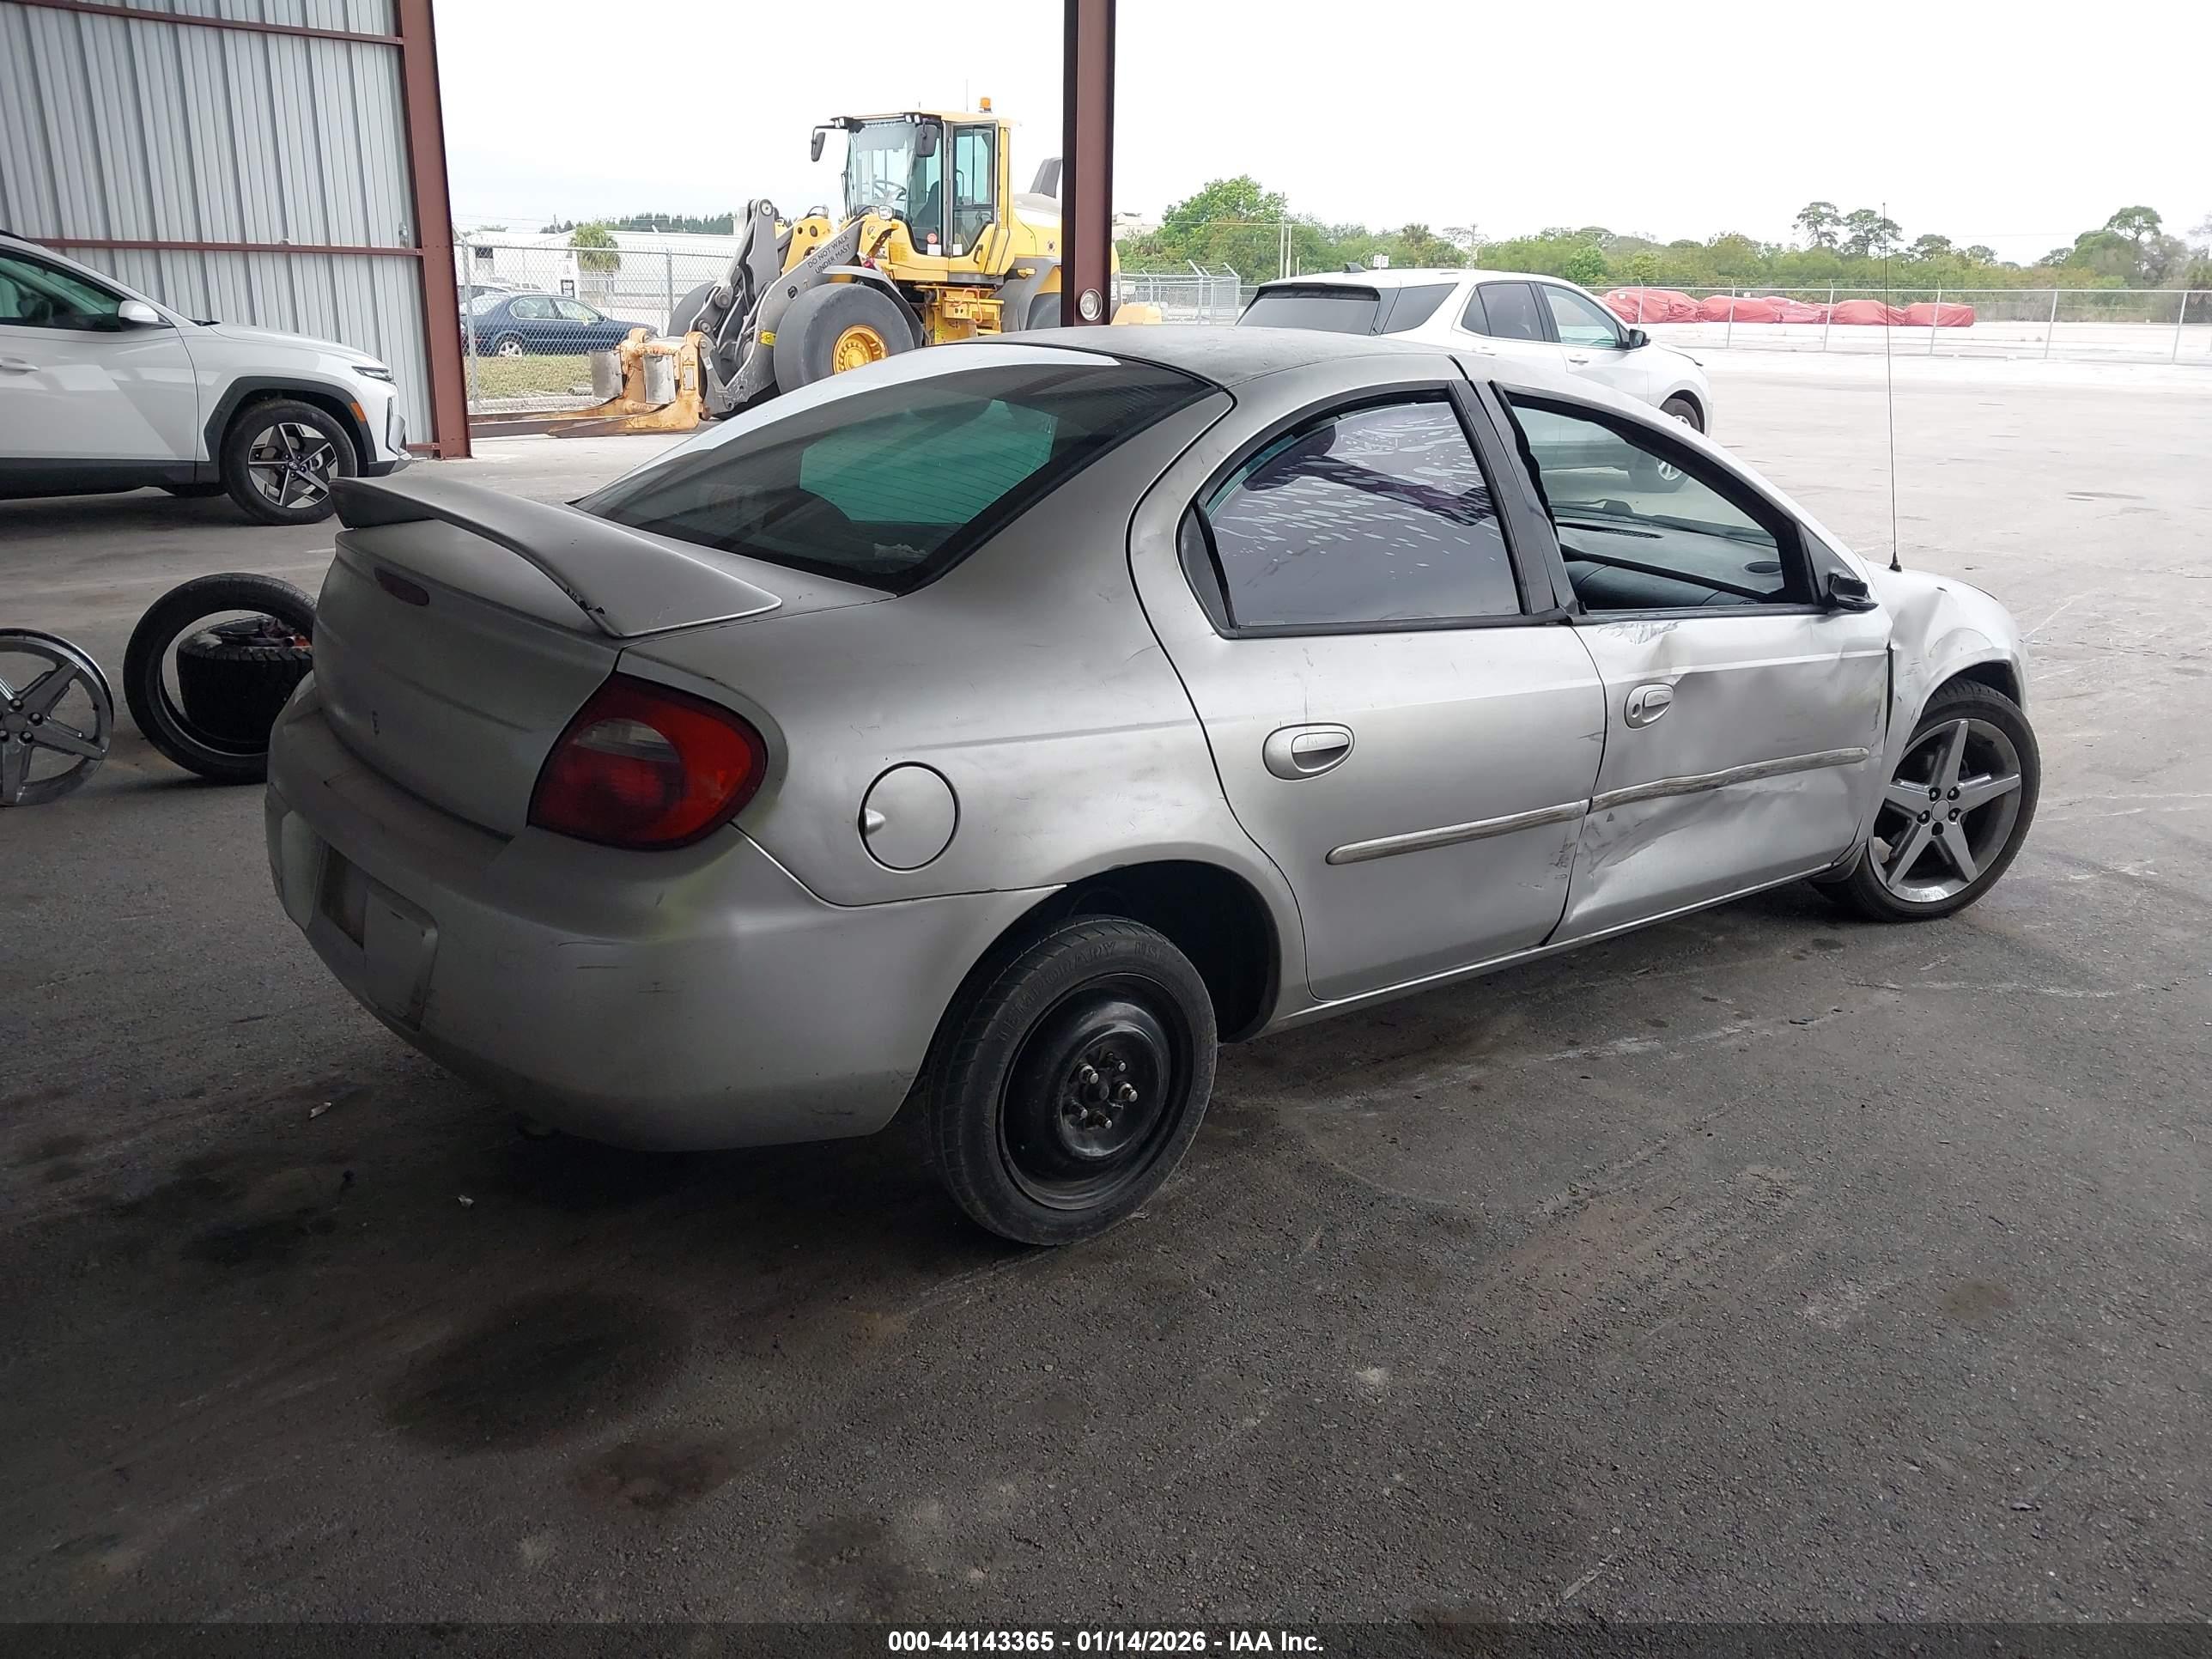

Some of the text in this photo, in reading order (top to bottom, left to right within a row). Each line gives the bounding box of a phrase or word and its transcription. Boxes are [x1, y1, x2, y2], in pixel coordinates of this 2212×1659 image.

[807, 234, 849, 269] DO NOT WALK
[815, 243, 851, 274] UNDER MAST
